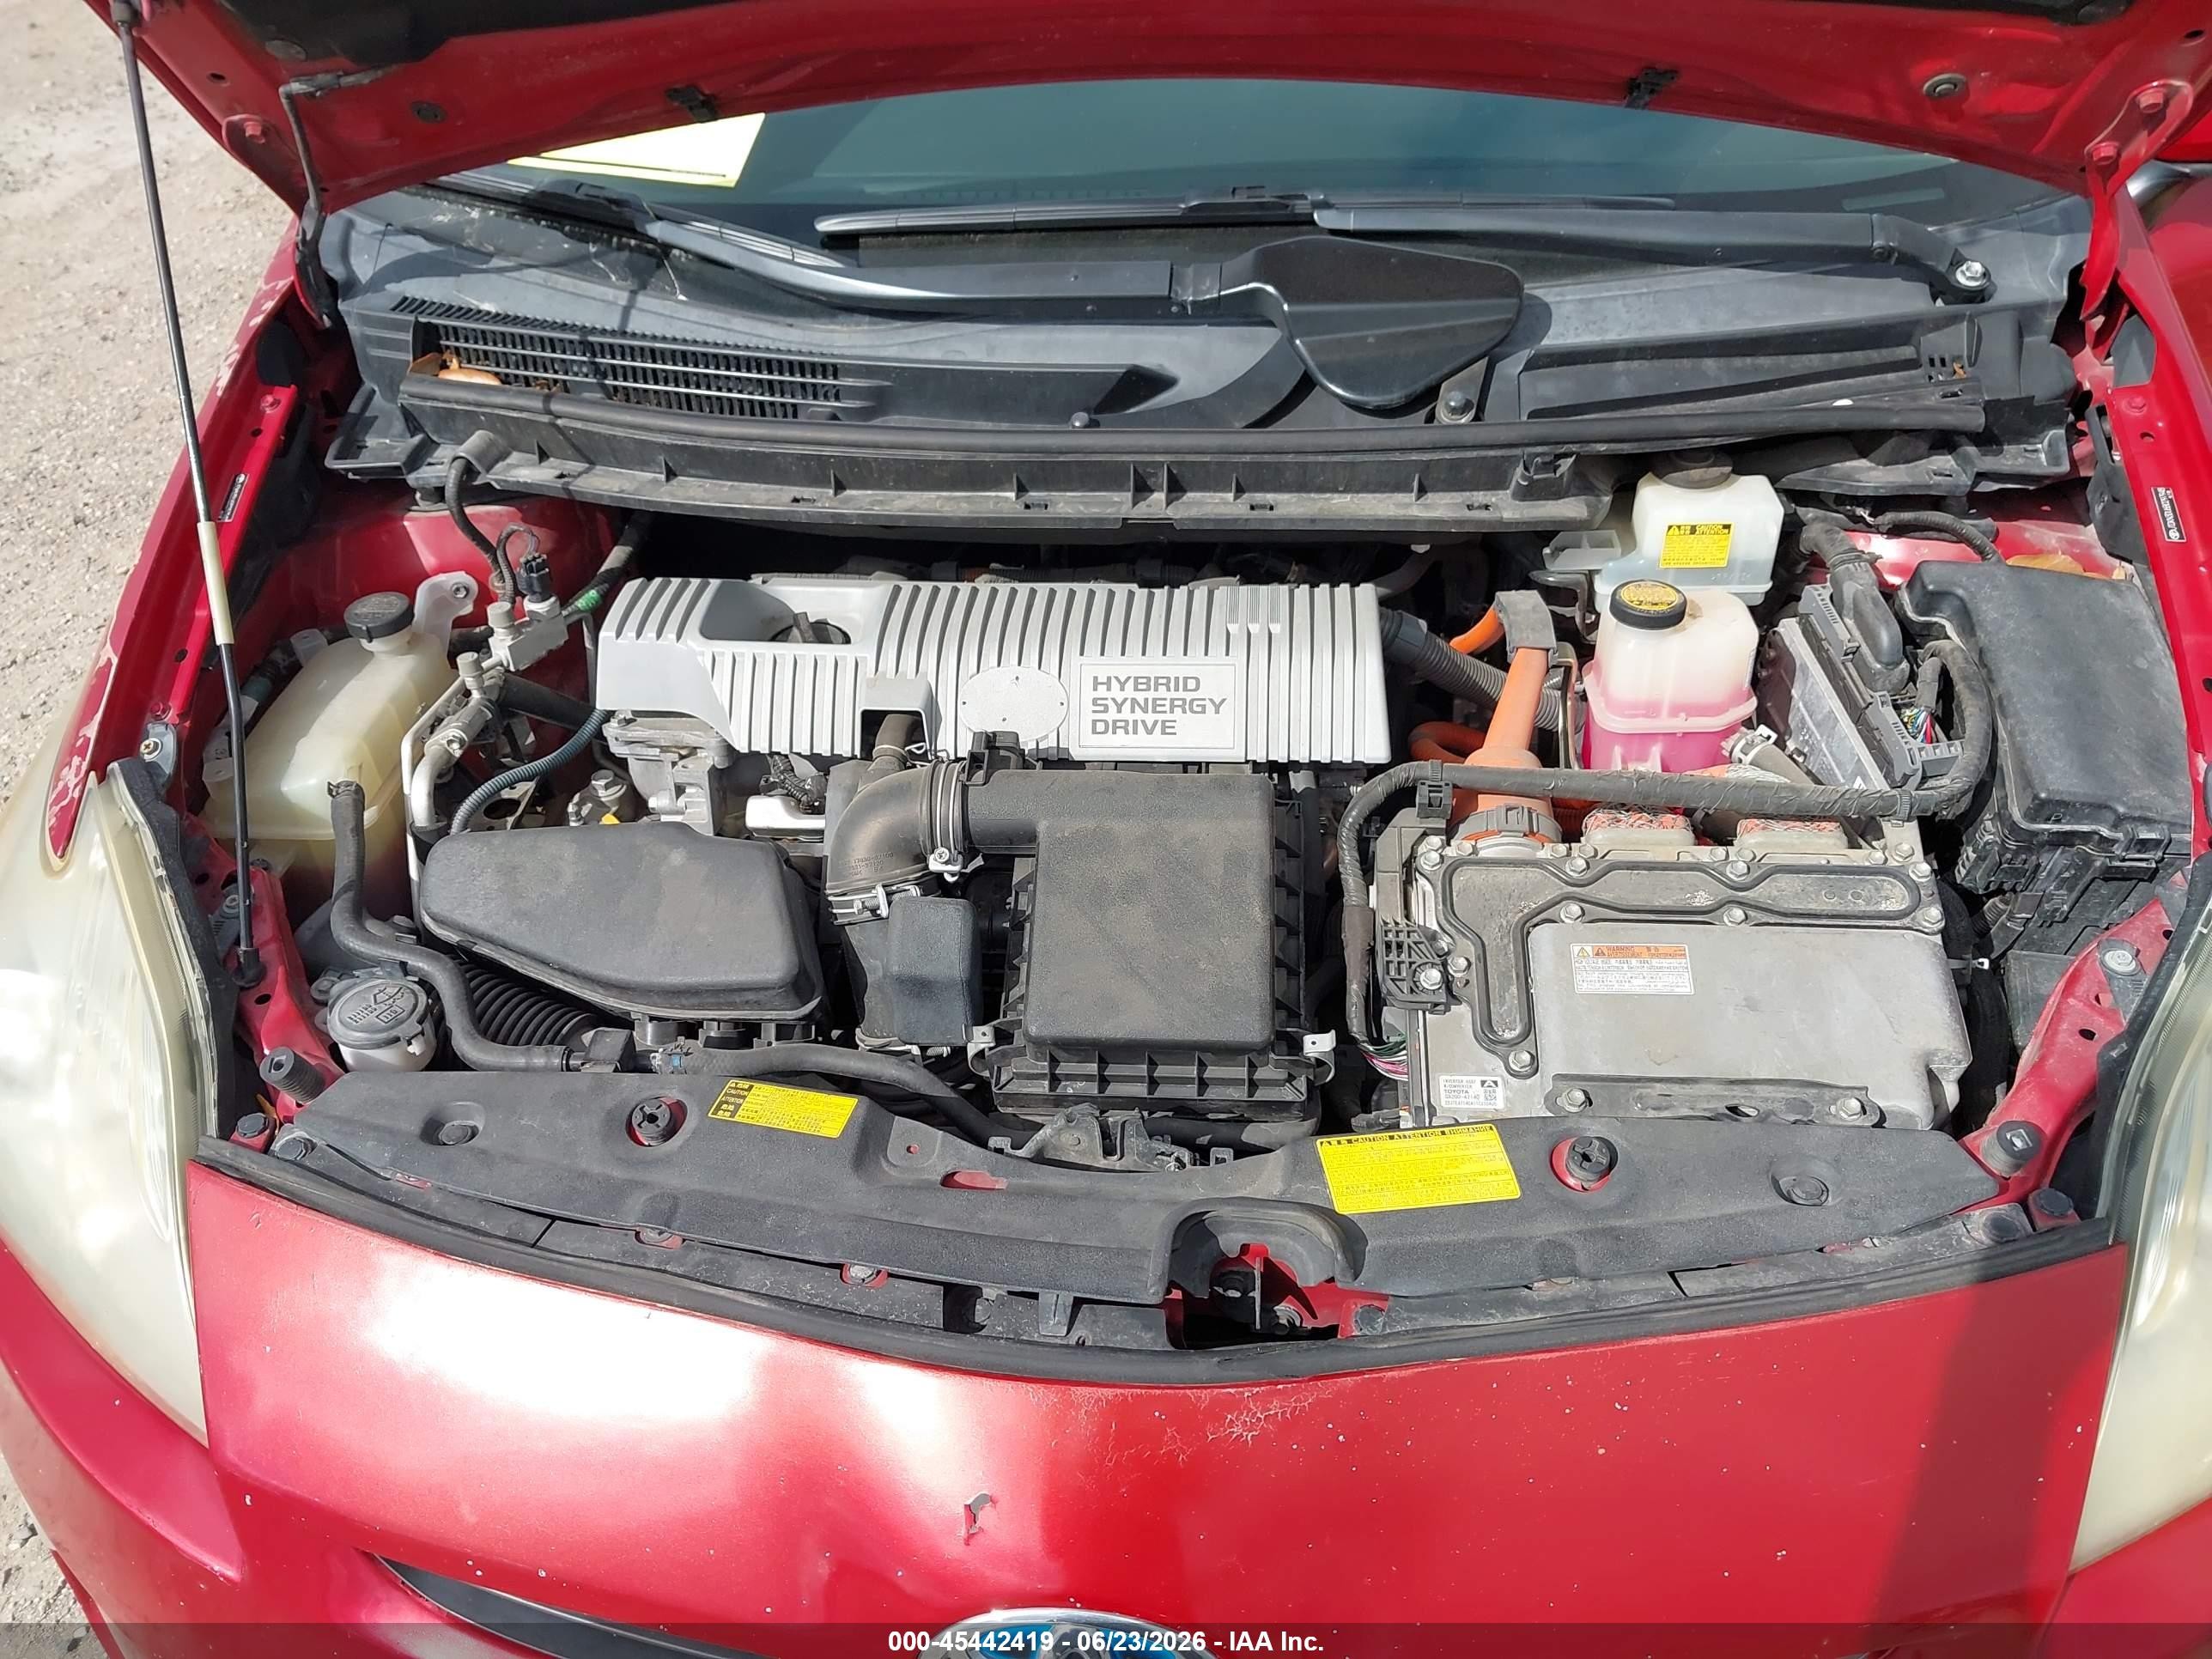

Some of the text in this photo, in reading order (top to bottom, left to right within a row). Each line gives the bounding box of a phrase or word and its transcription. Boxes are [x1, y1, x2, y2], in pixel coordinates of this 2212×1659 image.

[1092, 676, 1200, 692] HYBRID
[1091, 697, 1227, 714] SYNERGY
[1091, 719, 1177, 736] DRIVE
[1352, 1133, 1389, 1144] CAUTION
[1393, 1129, 1442, 1141] ATTENTION
